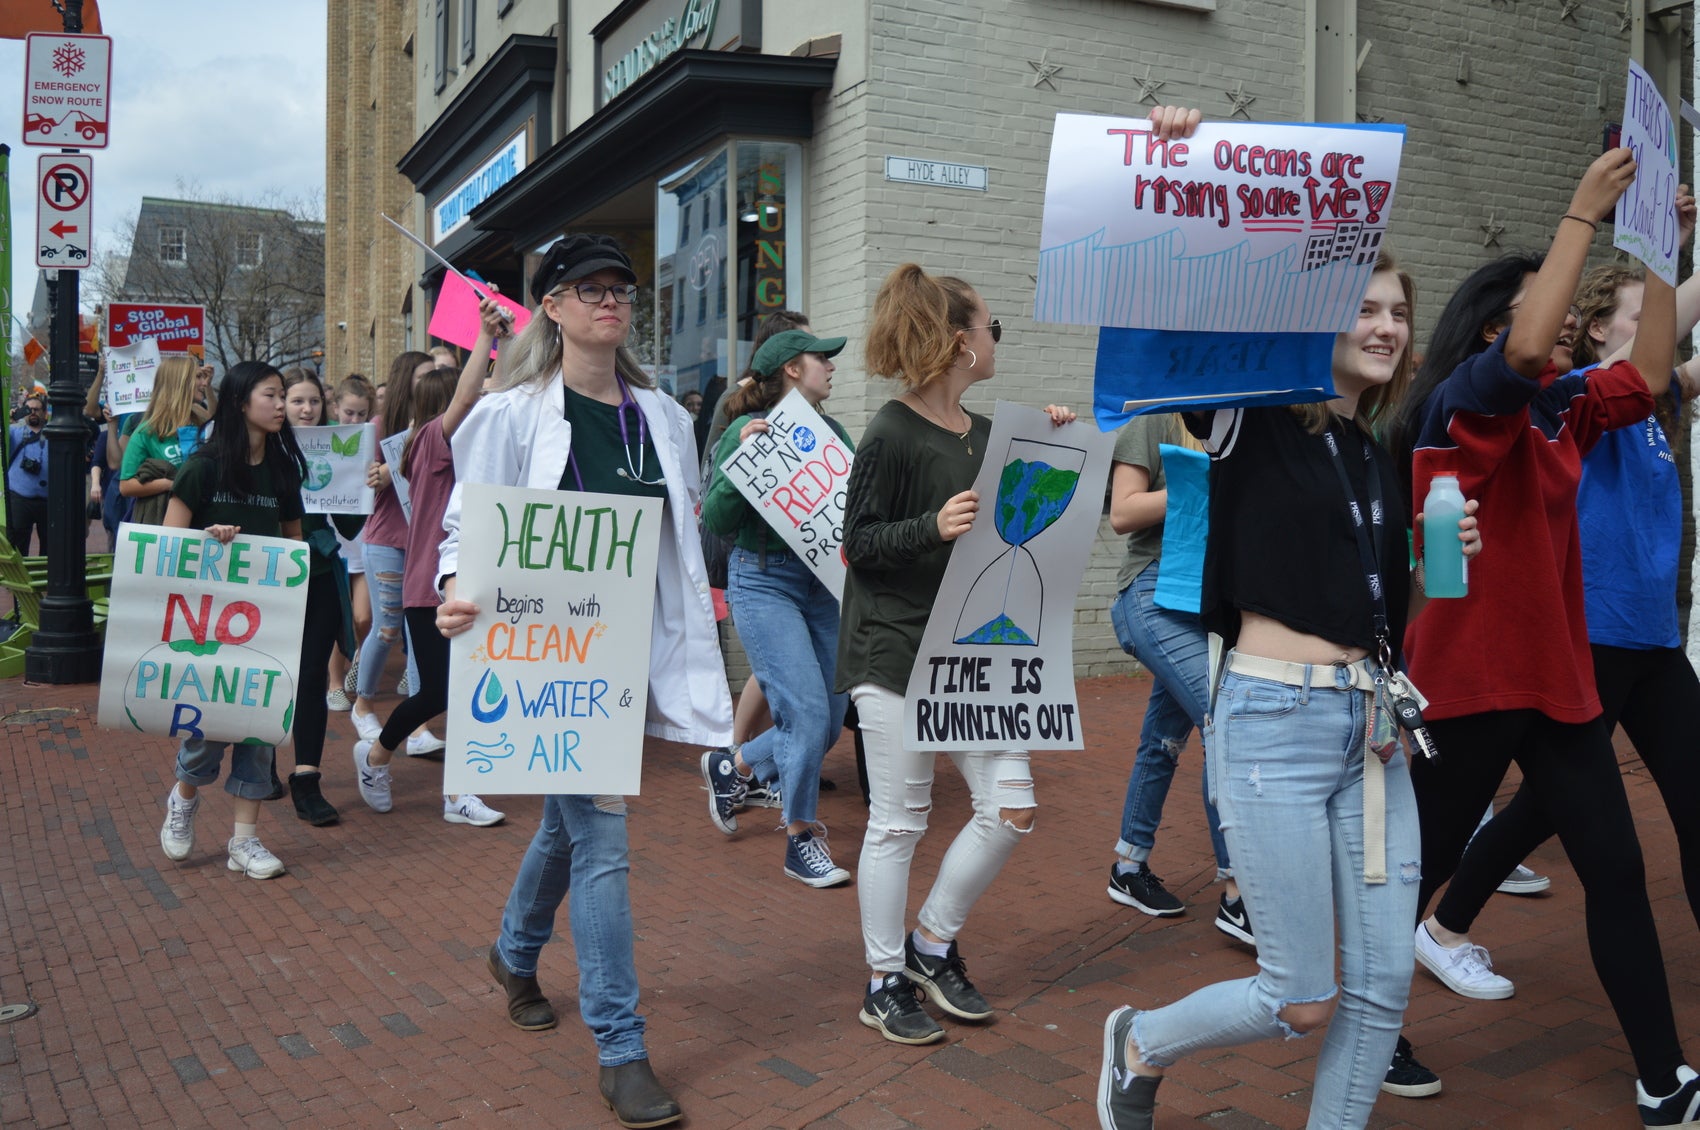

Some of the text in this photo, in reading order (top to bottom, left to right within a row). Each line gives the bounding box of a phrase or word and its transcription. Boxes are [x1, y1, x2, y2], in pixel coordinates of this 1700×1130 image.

[31, 95, 103, 107] SNOW ROUTE
[34, 81, 100, 93] EMERGENCY
[908, 161, 970, 185] HYDE ALLEY
[1107, 128, 1365, 179] The oceans are
[754, 163, 786, 323] SUNG
[128, 309, 165, 323] Stop
[138, 315, 190, 332] Global
[301, 438, 331, 451] solution
[725, 411, 796, 479] THERE
[305, 493, 359, 511] the pollution
[746, 467, 778, 500] IS
[799, 491, 848, 544] STO
[128, 531, 309, 587] THERE IS
[496, 502, 643, 577] HEALTH
[161, 593, 261, 645] NO
[496, 587, 601, 625] begins with
[486, 622, 595, 664] CLEAN
[928, 656, 1044, 694] TIME IS
[516, 679, 633, 719] WATER &
[916, 698, 1074, 743] RUNNING OUT
[528, 730, 582, 772] AIR
